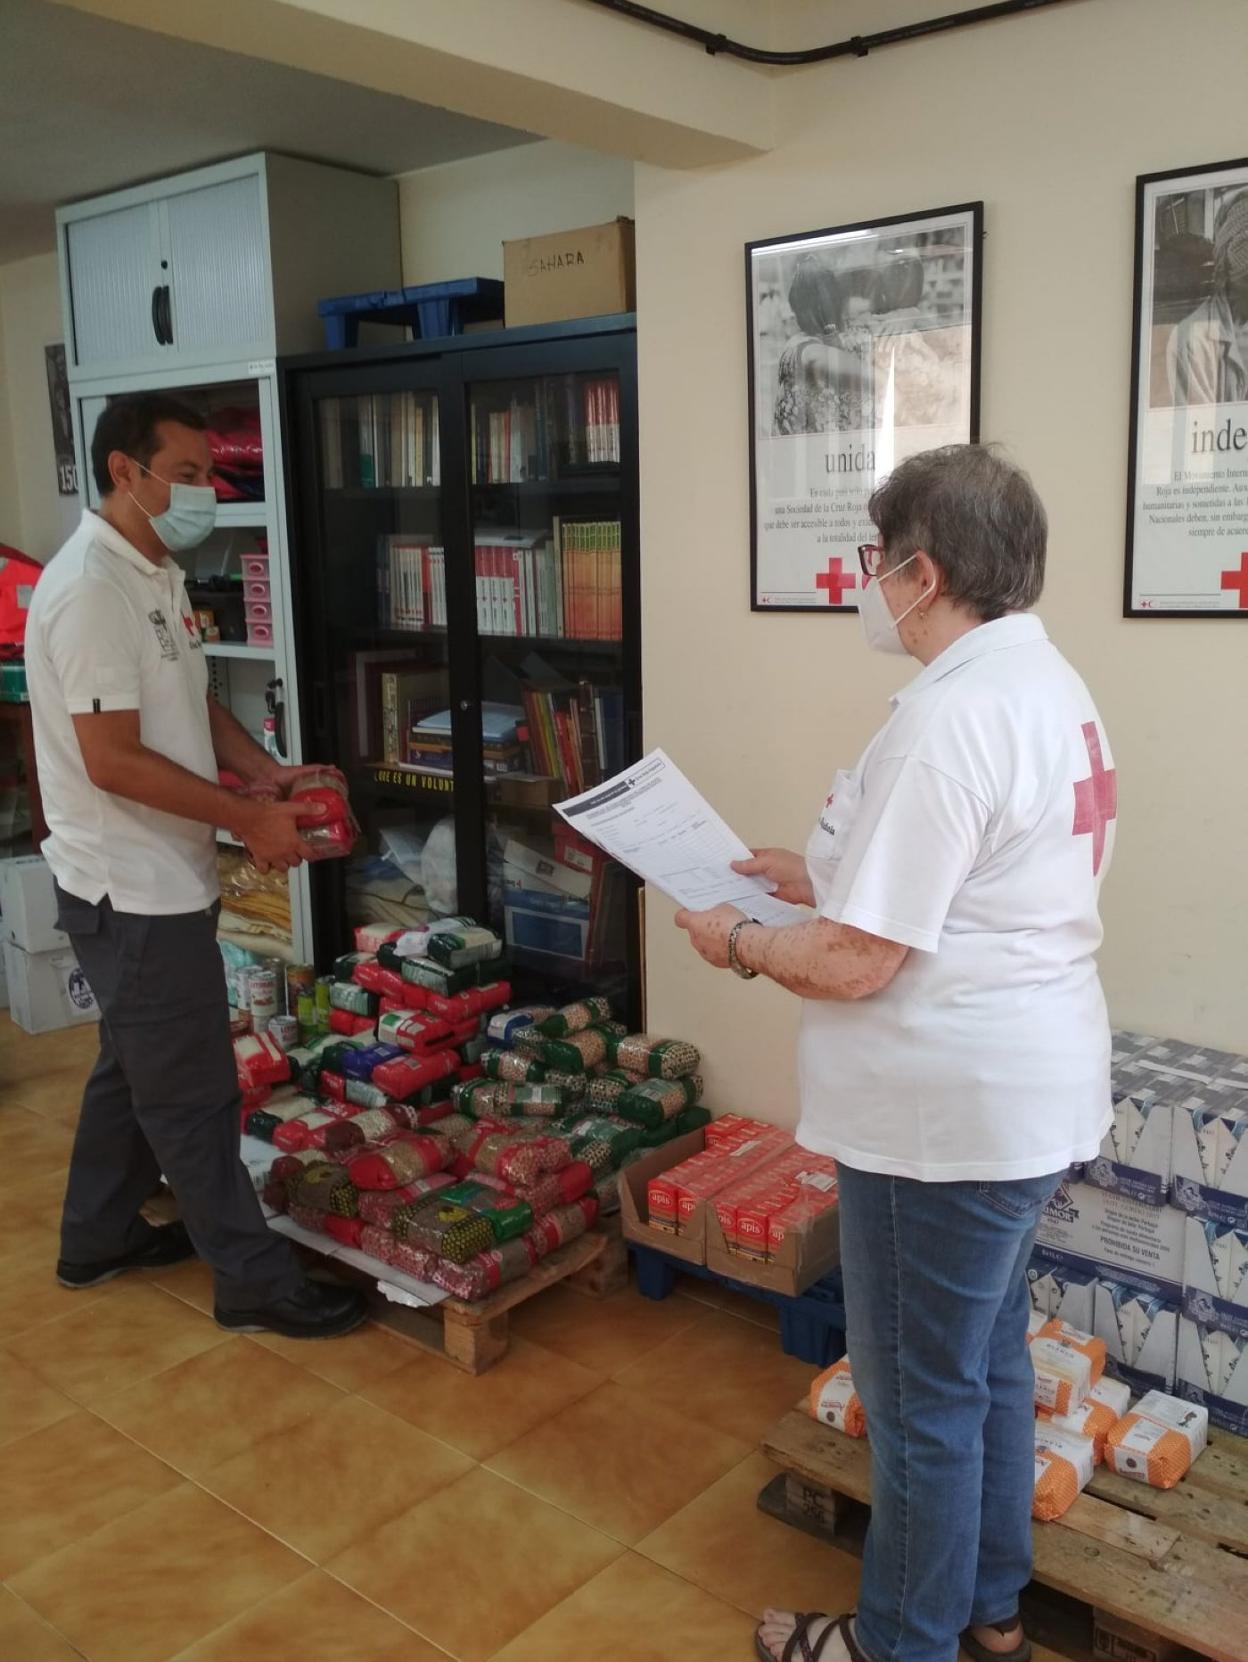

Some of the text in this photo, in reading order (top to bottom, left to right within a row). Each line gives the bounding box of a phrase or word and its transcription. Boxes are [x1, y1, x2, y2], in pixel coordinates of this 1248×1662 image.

[527, 251, 585, 277] SAHARA
[814, 503, 822, 513] de
[652, 1193, 670, 1206] apis
[740, 1221, 761, 1234] apis
